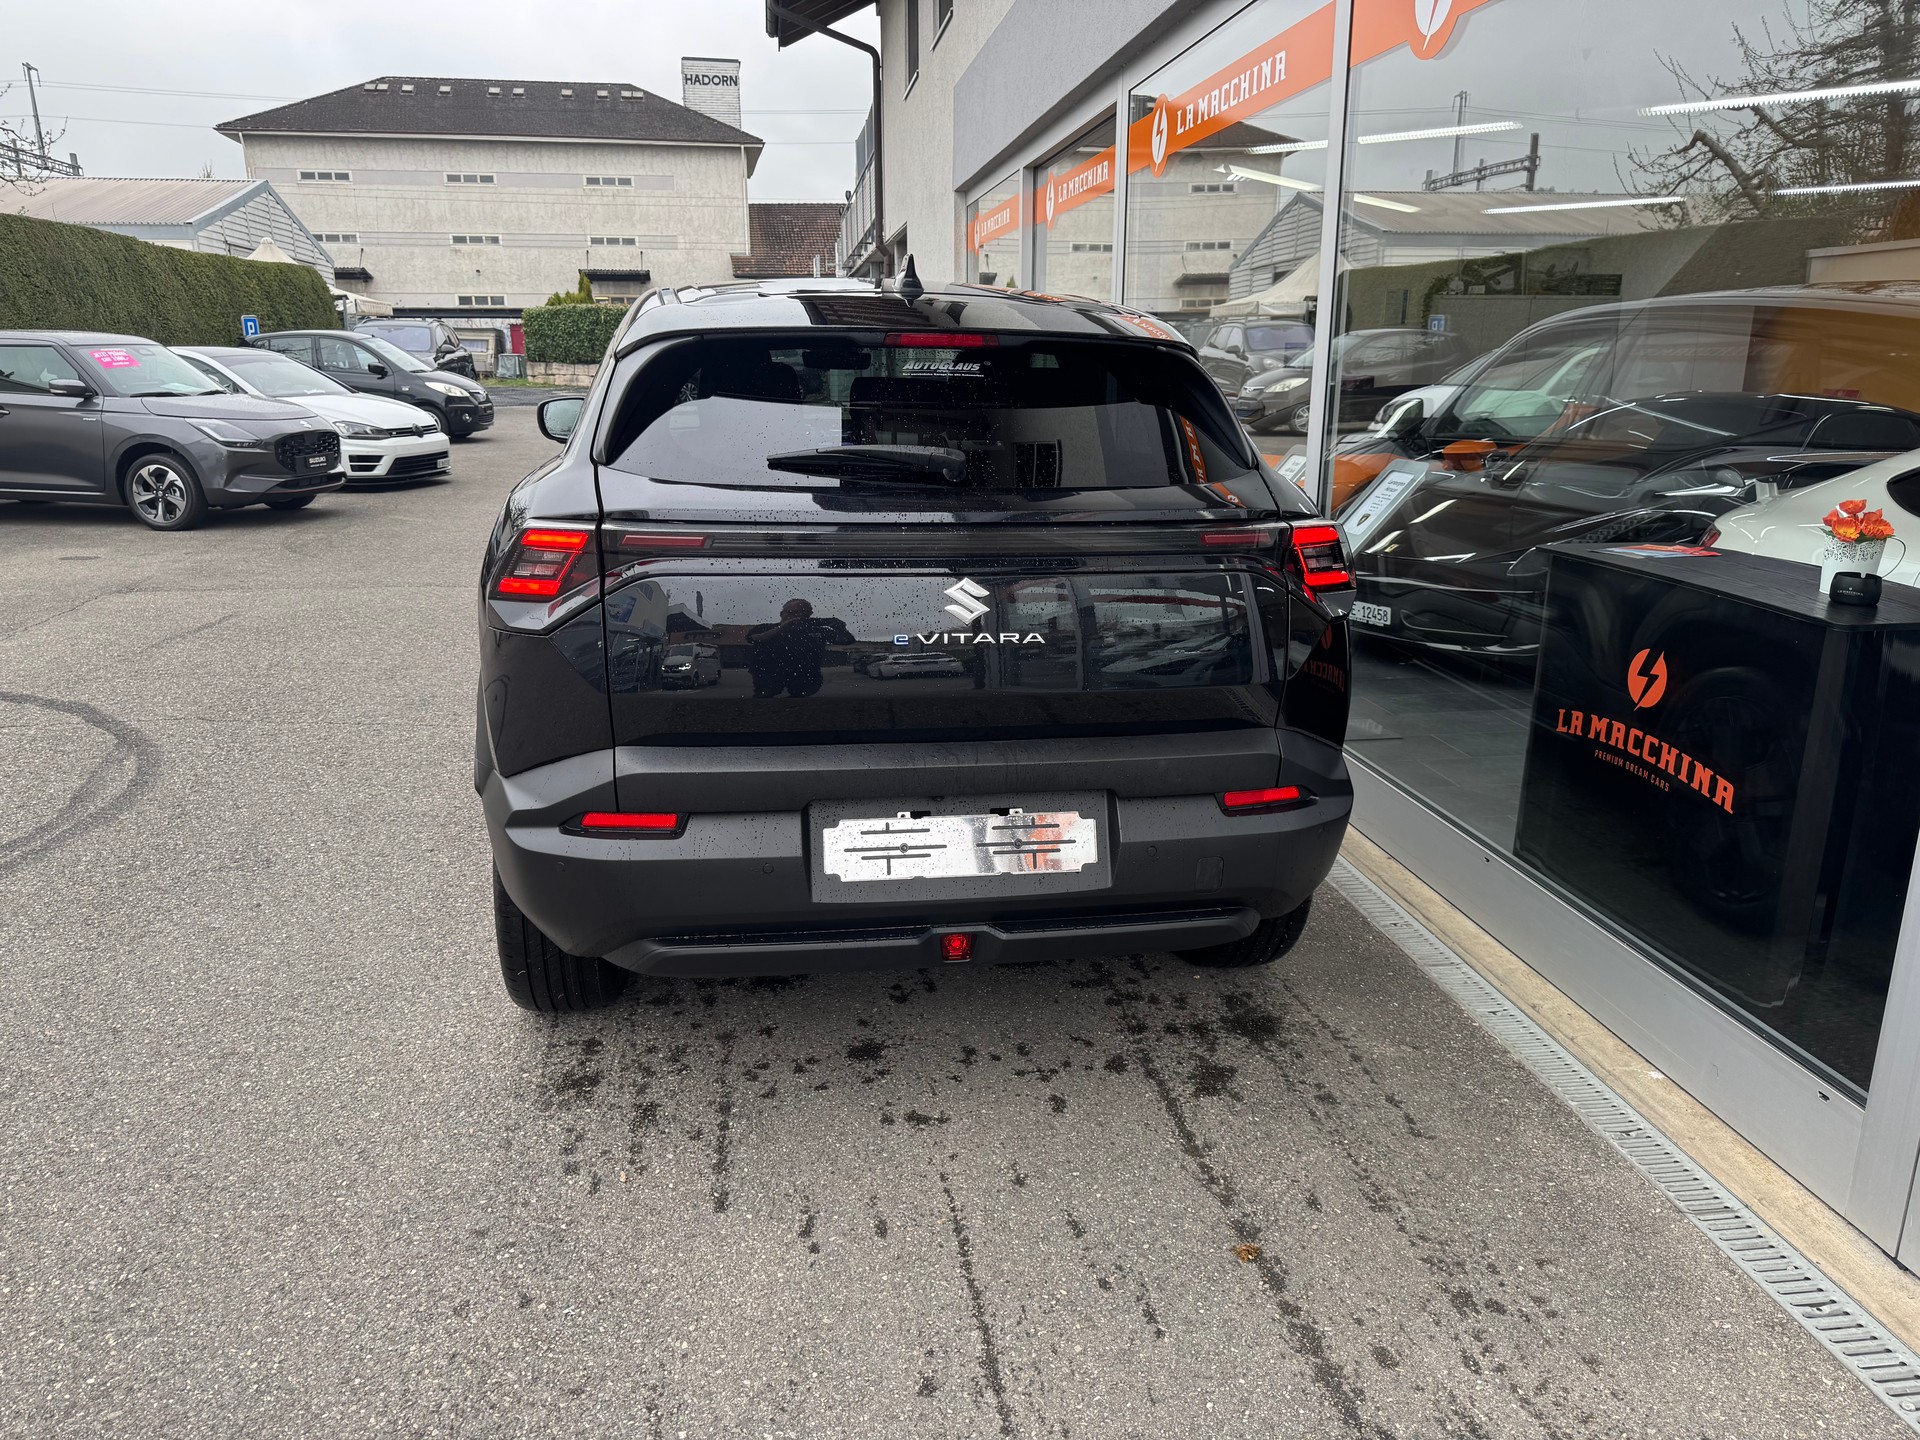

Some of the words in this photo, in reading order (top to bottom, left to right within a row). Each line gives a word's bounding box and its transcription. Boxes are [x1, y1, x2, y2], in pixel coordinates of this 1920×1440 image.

[684, 74, 738, 86] HADORN
[1176, 103, 1194, 135] LA
[1197, 50, 1286, 125] MACCHINA
[1058, 183, 1067, 203] LA
[1068, 160, 1109, 198] MACCHINA
[894, 634, 909, 645] e
[916, 633, 1046, 645] VITARA
[1556, 709, 1584, 736] LA
[1588, 714, 1735, 814] MACCHINA
[1594, 749, 1624, 768] PREMIUM
[1625, 762, 1649, 780] DREAM
[1651, 774, 1670, 792] CARS
